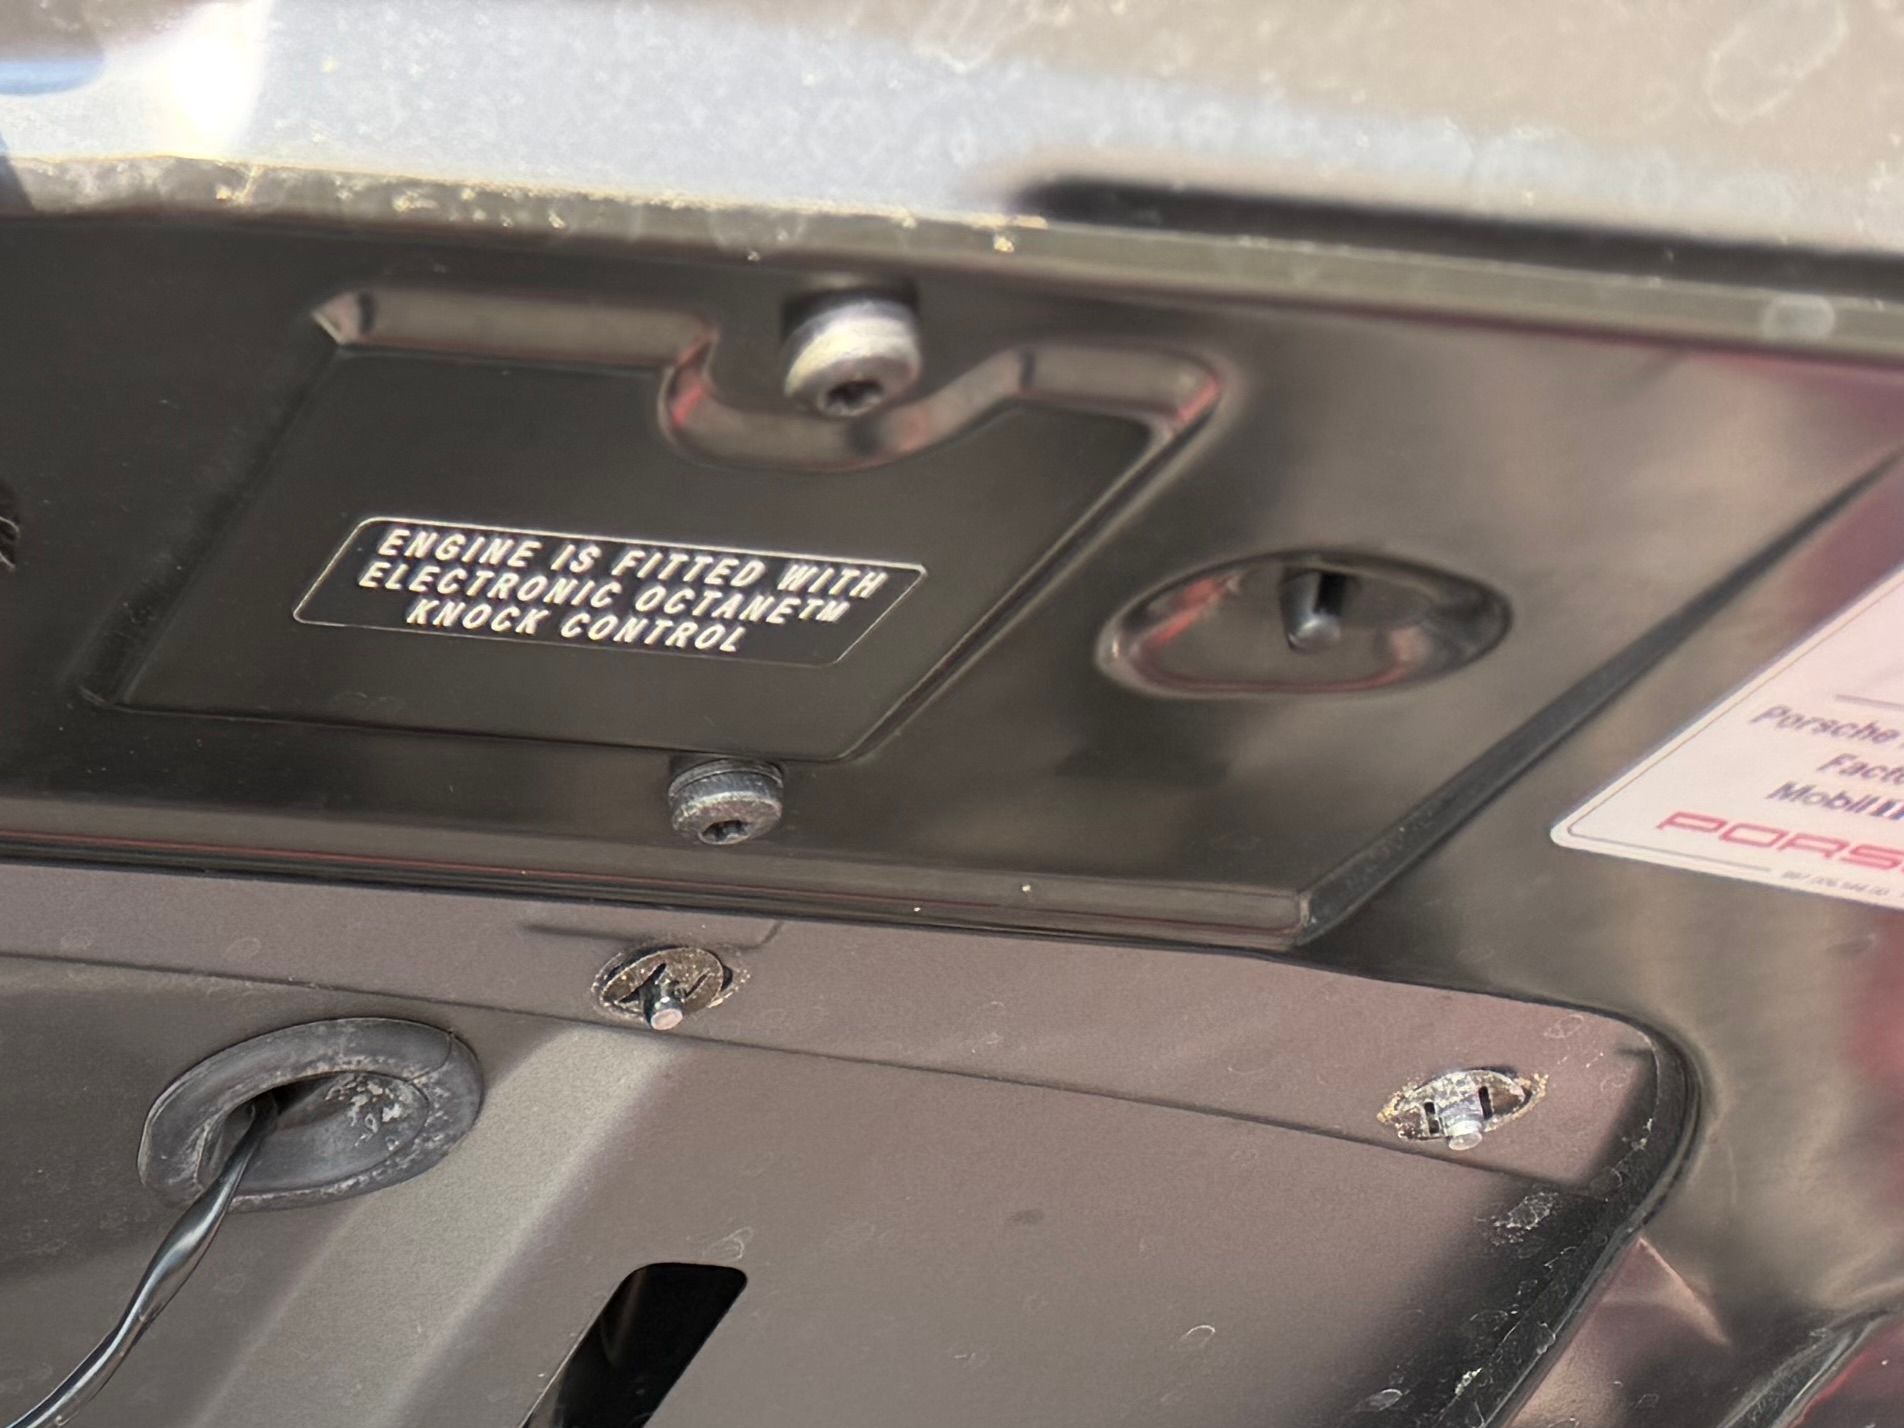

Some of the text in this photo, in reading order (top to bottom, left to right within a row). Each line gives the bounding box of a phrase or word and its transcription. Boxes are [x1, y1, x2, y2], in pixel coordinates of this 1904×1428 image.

[357, 561, 624, 609] ELECTRONIC
[377, 528, 889, 599] ENGINE IS FITTED WITH
[405, 599, 746, 652] KNOCK CONTROL
[1749, 705, 1900, 744] Porsche
[1656, 811, 1904, 873] PORS
